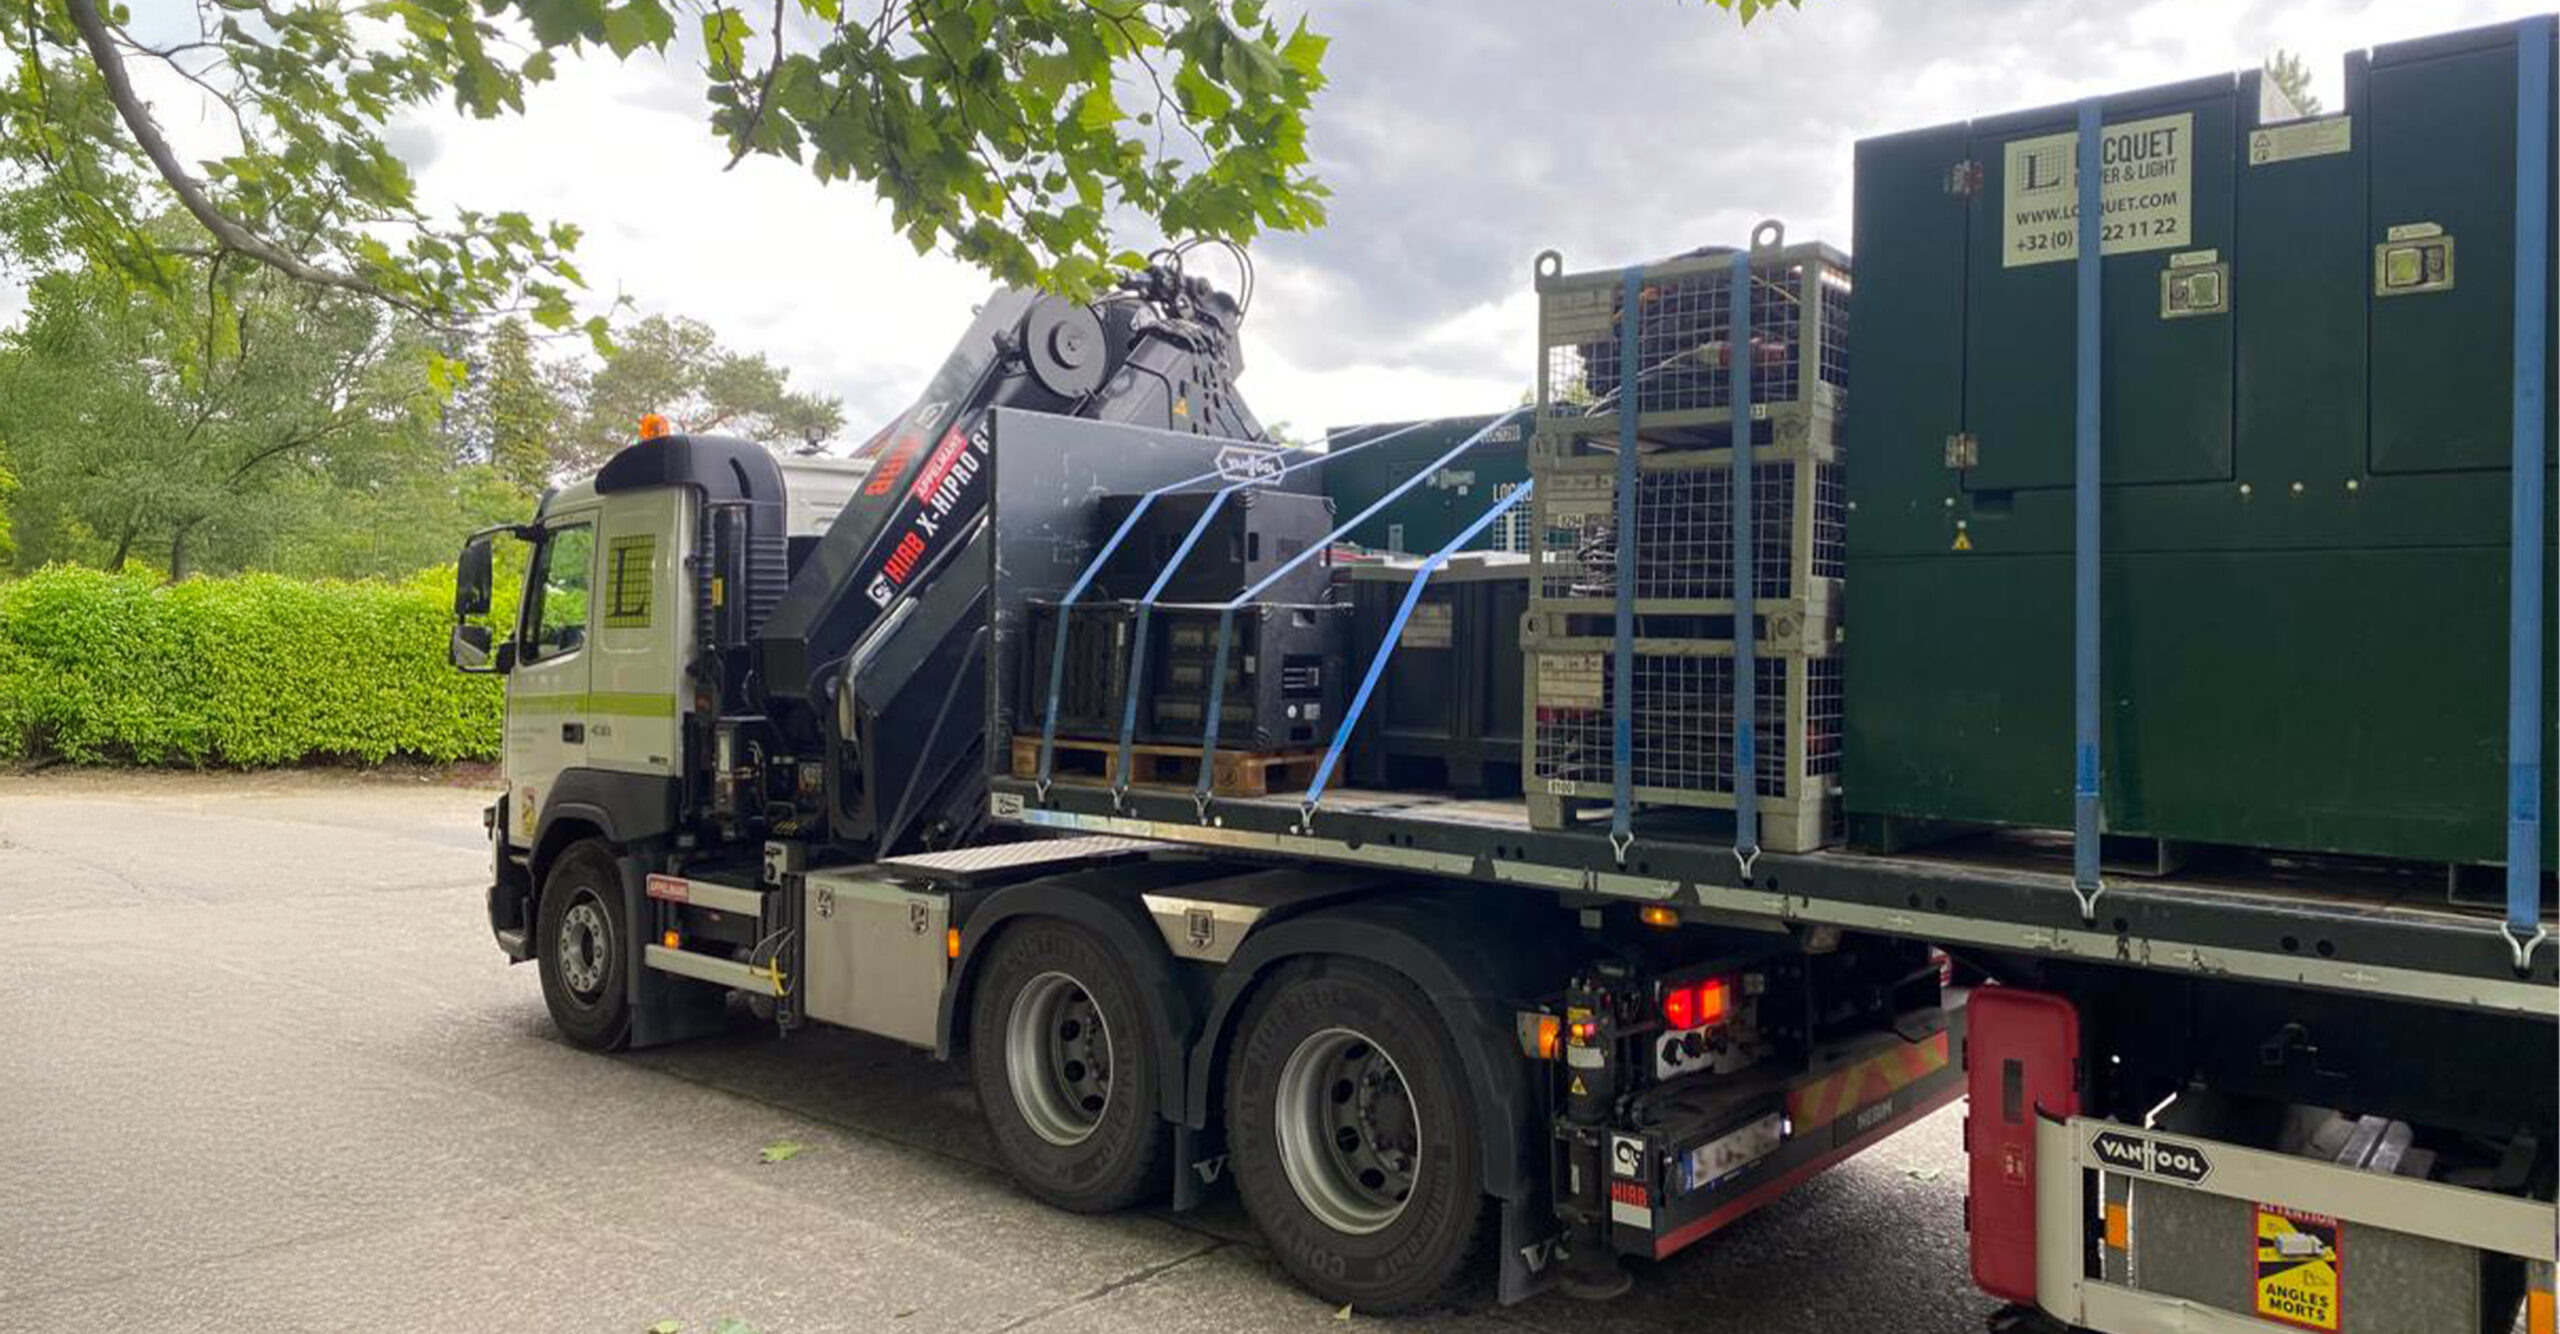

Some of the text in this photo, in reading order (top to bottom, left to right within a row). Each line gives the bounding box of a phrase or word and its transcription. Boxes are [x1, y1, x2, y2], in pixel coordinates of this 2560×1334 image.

[2076, 127, 2178, 169] CQUET
[2139, 159, 2177, 179] LIGHT
[2017, 192, 2178, 225] WWW.LOUET.COM
[2017, 217, 2177, 251] +32 (0) 22 11 22
[883, 531, 926, 584] HIAB
[915, 451, 980, 538] X-HIPRO
[1610, 1181, 1647, 1207] HIAB
[2266, 1283, 2329, 1308] ANGLES
[2269, 1297, 2326, 1321] MORTS
